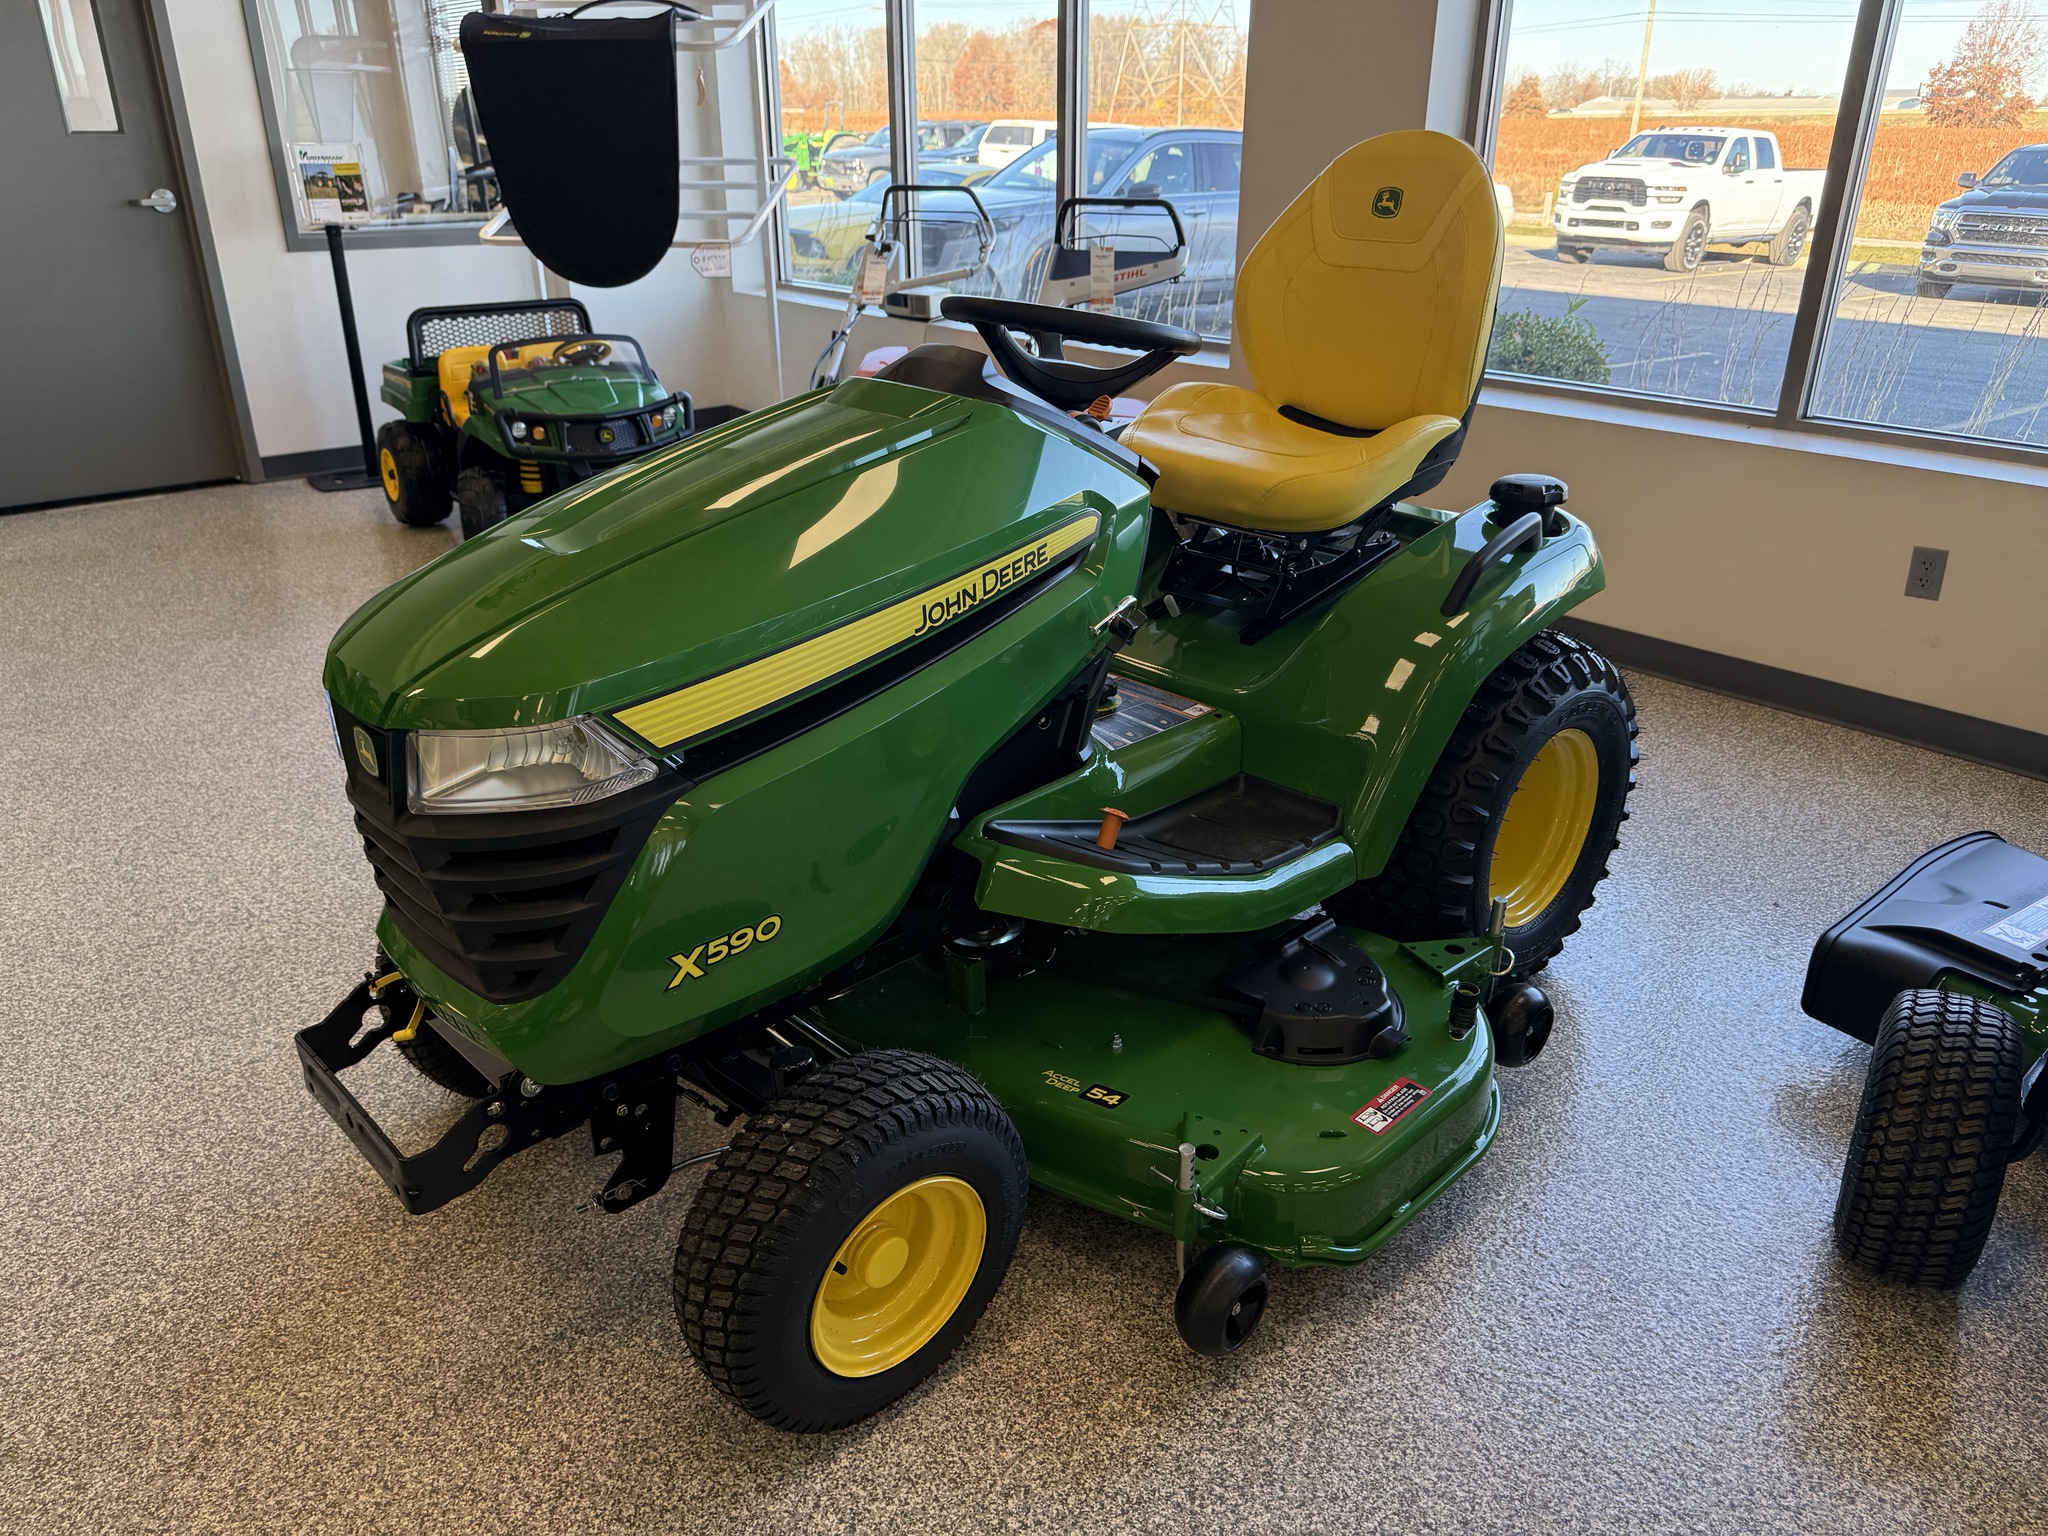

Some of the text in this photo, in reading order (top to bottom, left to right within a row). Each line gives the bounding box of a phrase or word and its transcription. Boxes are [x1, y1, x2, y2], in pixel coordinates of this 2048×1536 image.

[1114, 269, 1147, 282] STIHL
[914, 542, 1049, 635] JOHN DEERE
[664, 913, 782, 991] X590
[1041, 1069, 1080, 1087] ACCEL
[1045, 1077, 1080, 1093] DEEP
[1085, 1087, 1121, 1105] 54
[1379, 1084, 1400, 1099] DANGER
